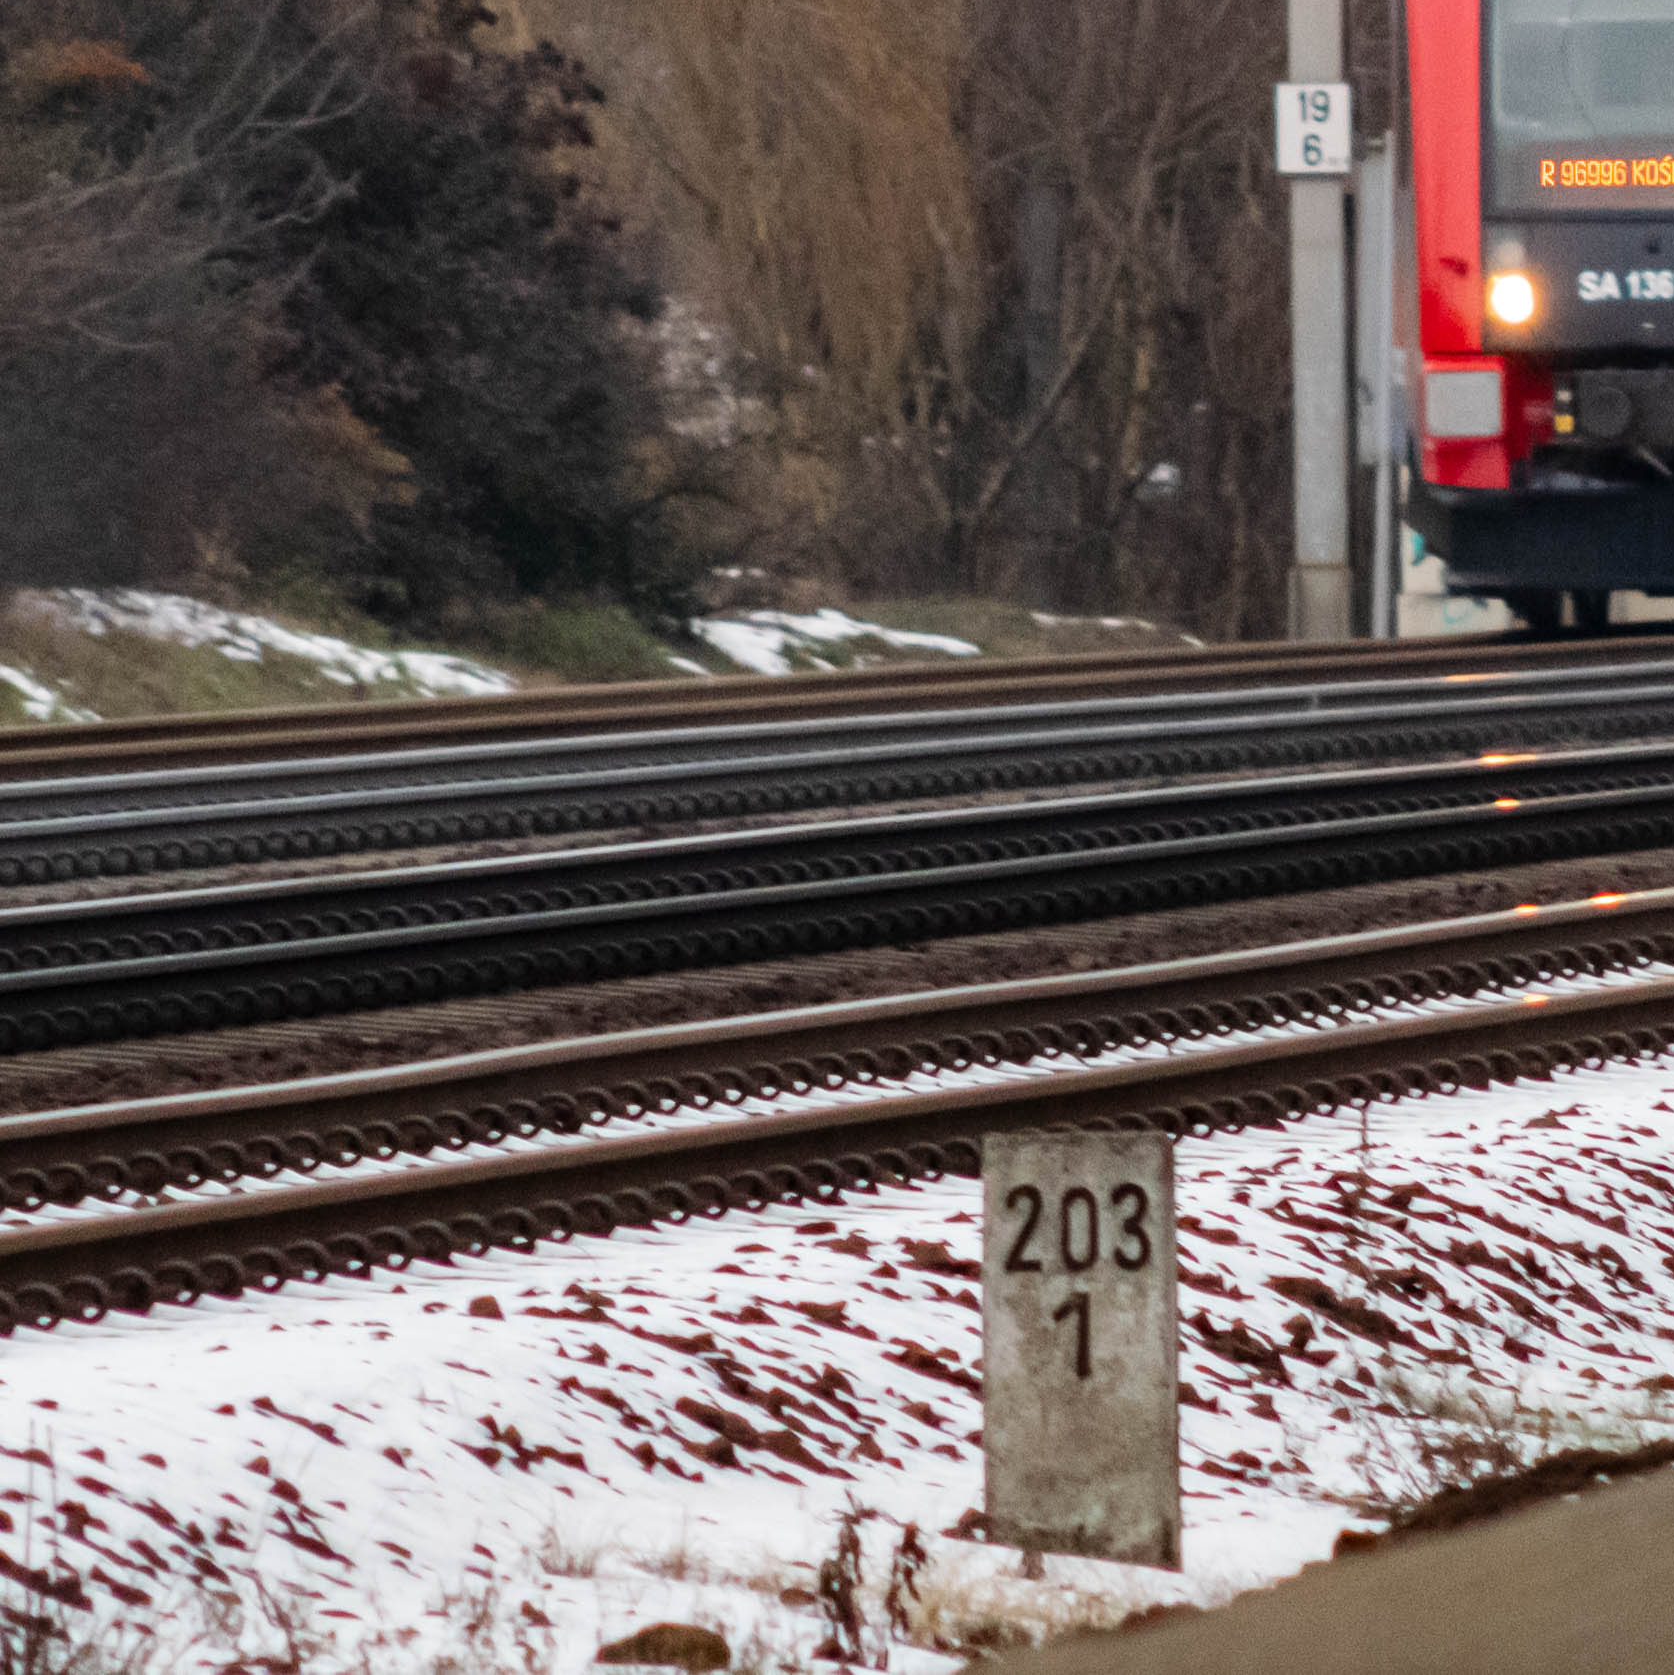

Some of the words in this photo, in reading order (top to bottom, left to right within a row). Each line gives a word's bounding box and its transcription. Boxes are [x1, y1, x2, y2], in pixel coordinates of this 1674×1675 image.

[1298, 89, 1331, 123] 19
[1303, 133, 1323, 166] 6
[1541, 159, 1555, 186] R
[1560, 159, 1626, 186] 96996
[1577, 270, 1622, 301] SA
[1004, 1182, 1151, 1273] 203
[1053, 1291, 1092, 1380] 1
